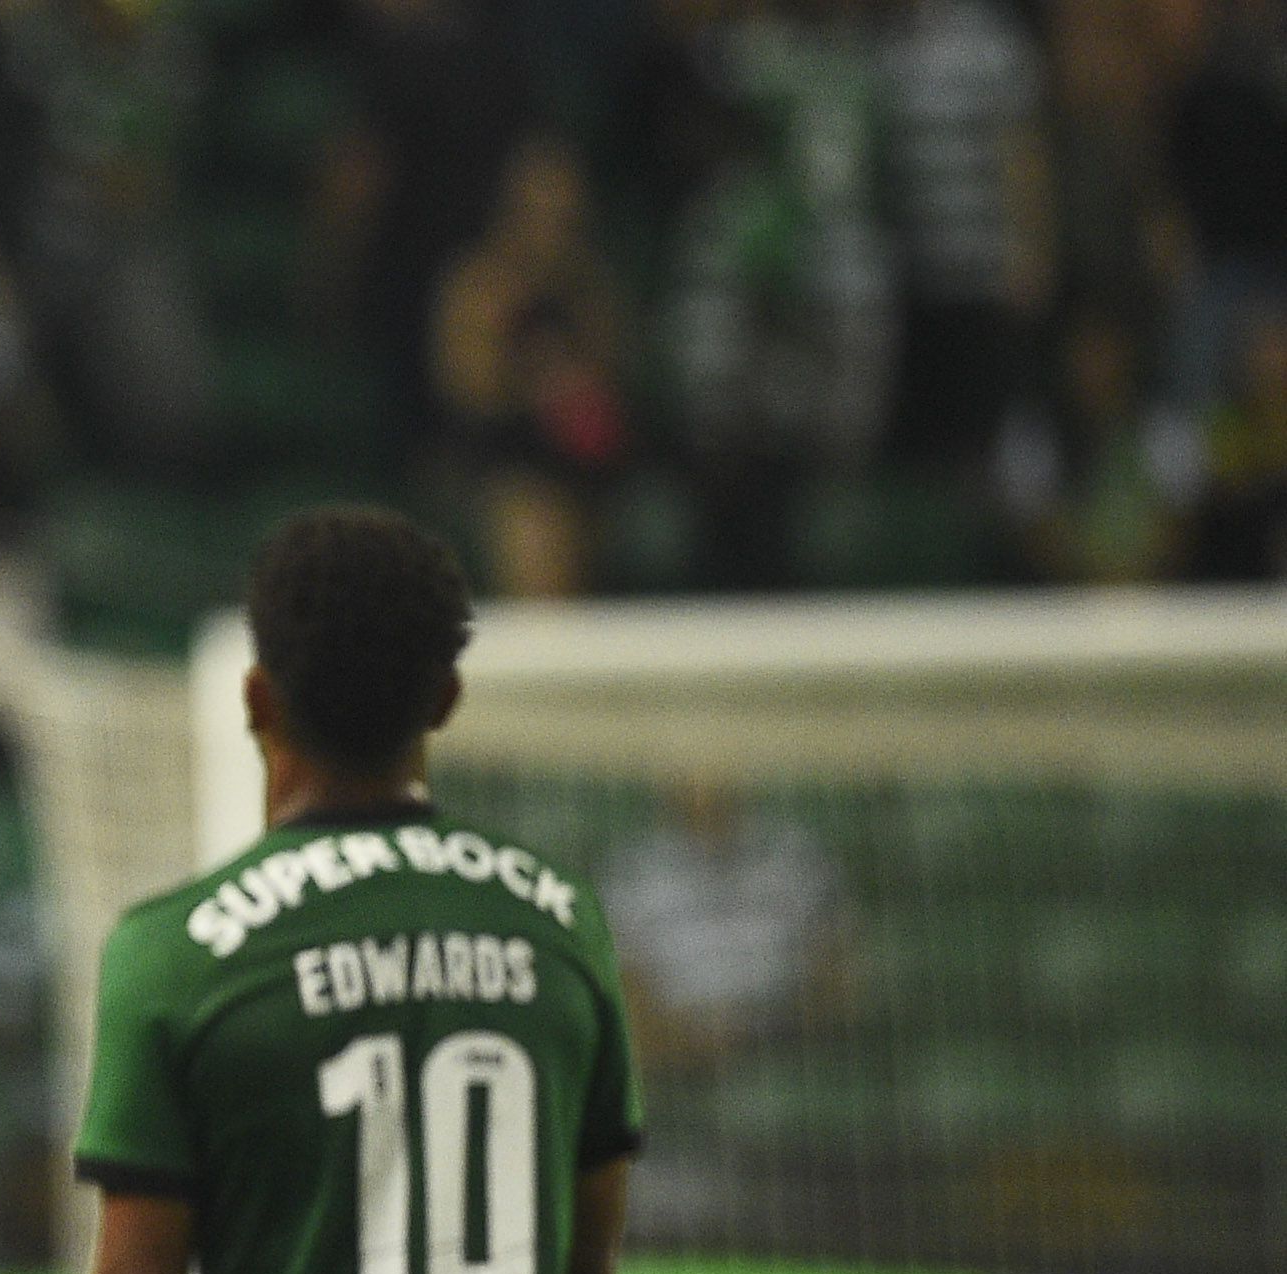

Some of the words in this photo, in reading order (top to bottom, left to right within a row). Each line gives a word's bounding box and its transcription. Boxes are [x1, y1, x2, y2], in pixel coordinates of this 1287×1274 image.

[186, 832, 399, 958] SUPER
[396, 826, 577, 926] BOCK
[293, 931, 537, 1017] EDWARDS
